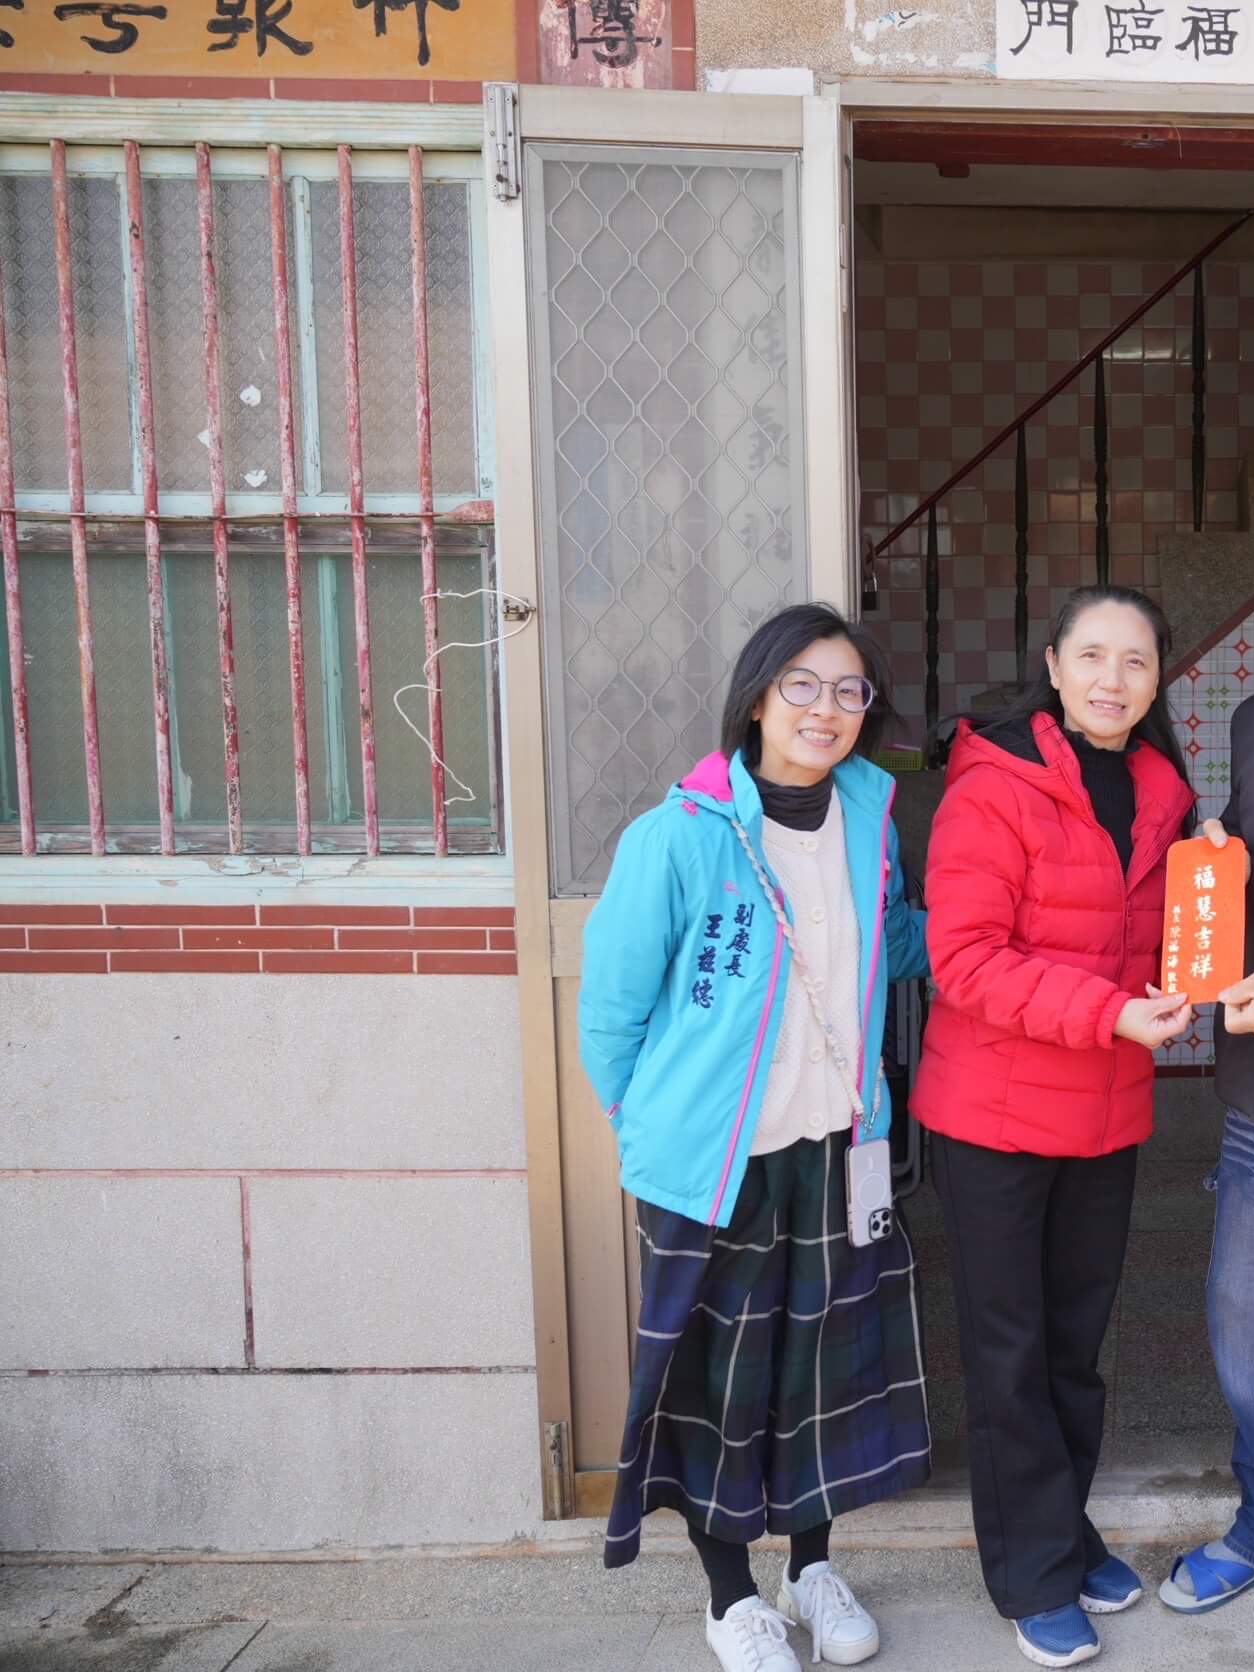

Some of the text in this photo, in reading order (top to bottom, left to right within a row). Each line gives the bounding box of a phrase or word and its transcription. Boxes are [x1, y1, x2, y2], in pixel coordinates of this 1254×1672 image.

[724, 903, 755, 978] 副處長
[1189, 865, 1216, 980] 福慧吉祥
